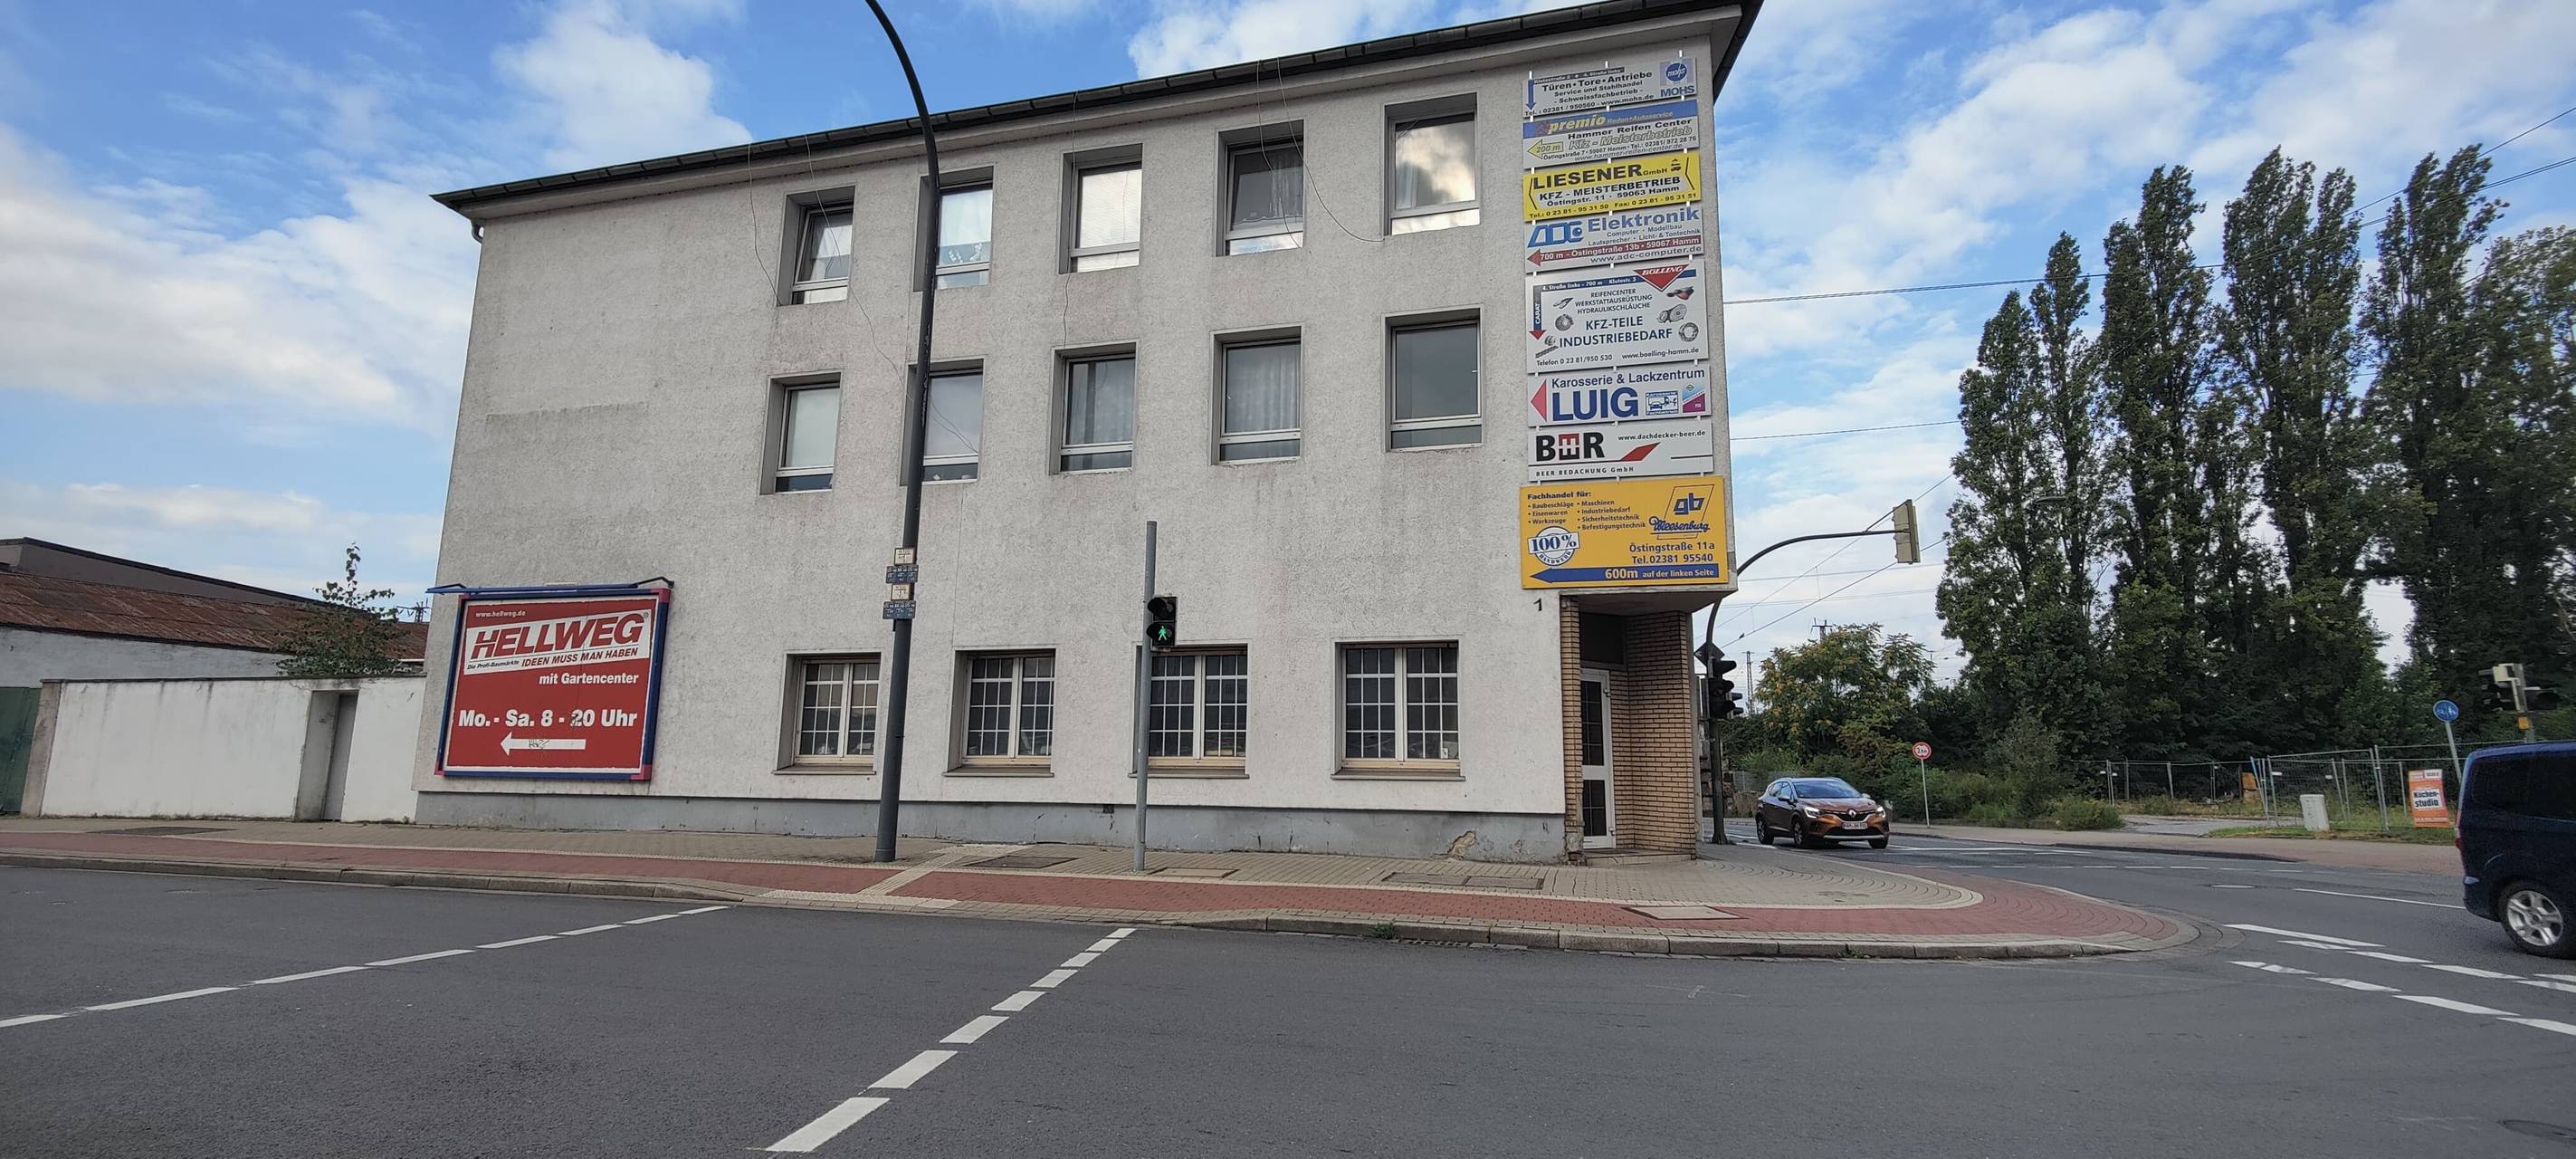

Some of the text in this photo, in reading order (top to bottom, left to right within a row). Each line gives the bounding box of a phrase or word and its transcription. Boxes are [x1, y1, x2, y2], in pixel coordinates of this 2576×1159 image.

[1541, 81, 1572, 91] Türen
[1579, 79, 1601, 87] Tore
[1608, 72, 1653, 83] Antriebe
[1554, 89, 1581, 97] Service
[1598, 80, 1643, 91] Stahlhandel
[1660, 85, 1695, 97] MOHS
[1559, 89, 1638, 103] Schweissfachbetrieb
[1601, 94, 1655, 106] www.mohs.de
[1547, 114, 1606, 135] premio
[1568, 119, 1693, 140] Hammer Reifen Center
[1569, 139, 1590, 150] Kfz
[1599, 126, 1693, 146] Meisterbetrieb
[1536, 145, 1550, 153] 200
[1533, 164, 1667, 189] LIESENER GmbH
[1540, 191, 1563, 201] KFZ
[1573, 176, 1681, 196] MEISTERBETRIEB
[1617, 189, 1646, 198] 59063
[1648, 186, 1680, 195] Hamm
[1588, 206, 1700, 233] Elektronik
[1588, 236, 1630, 246] Lautsprecher
[1665, 228, 1701, 237] Tontechnik
[1607, 224, 1683, 237] Computer Modellbau
[1625, 243, 1639, 251] 13b
[1646, 239, 1671, 248] 59067
[1672, 236, 1700, 245] Hamm
[1590, 245, 1702, 263] www.adc-computer.de
[1590, 288, 1636, 298] REIFENCENTER
[1575, 294, 1653, 307] WERKSTATTAUSRÜSTUNG
[1577, 302, 1651, 314] HYDRAULIKSCHLÄUCHE
[1586, 315, 1644, 330] KFZ-TEILE
[1560, 328, 1673, 348] INDUSTRIEBEDARF
[1621, 347, 1700, 359] www.boelling-hamm.de
[1536, 359, 1559, 367] Telefon
[1576, 355, 1598, 363] 81/950
[1551, 369, 1705, 388] Karosserie & Lackzentrum
[1552, 387, 1639, 422] LUIG
[1617, 429, 1706, 442] www.dachdecker-beer.de
[1559, 466, 1608, 476] BEDACHUNG
[1610, 465, 1634, 474] GmbH
[1527, 491, 1573, 501] Fachhandel
[1531, 502, 1574, 510] Baubeschläge
[1581, 499, 1615, 507] Maschinen
[1581, 514, 1640, 522] Sicherheitstechnik
[1648, 516, 1711, 532] Meesenburg
[1581, 522, 1646, 531] Befestigungstechnik
[1531, 534, 1577, 552] 100%
[1696, 541, 1715, 551] 11a
[1683, 553, 1713, 562] 95540
[1605, 568, 1638, 580] 600m
[1694, 569, 1714, 577] Seite
[1533, 598, 1542, 611] 1
[475, 610, 526, 618] www.hellweg.de
[471, 613, 645, 659] HELLWEG
[521, 656, 550, 667] IDEEN
[551, 653, 578, 665] MUSS
[580, 650, 603, 662] MAN
[605, 647, 638, 659] HABEN
[539, 673, 639, 685] mit Gartencenter
[505, 709, 535, 727] Sa.
[540, 709, 553, 727] 8
[570, 709, 595, 728] 20
[601, 708, 638, 727] Uhr
[2414, 799, 2439, 808] studio
